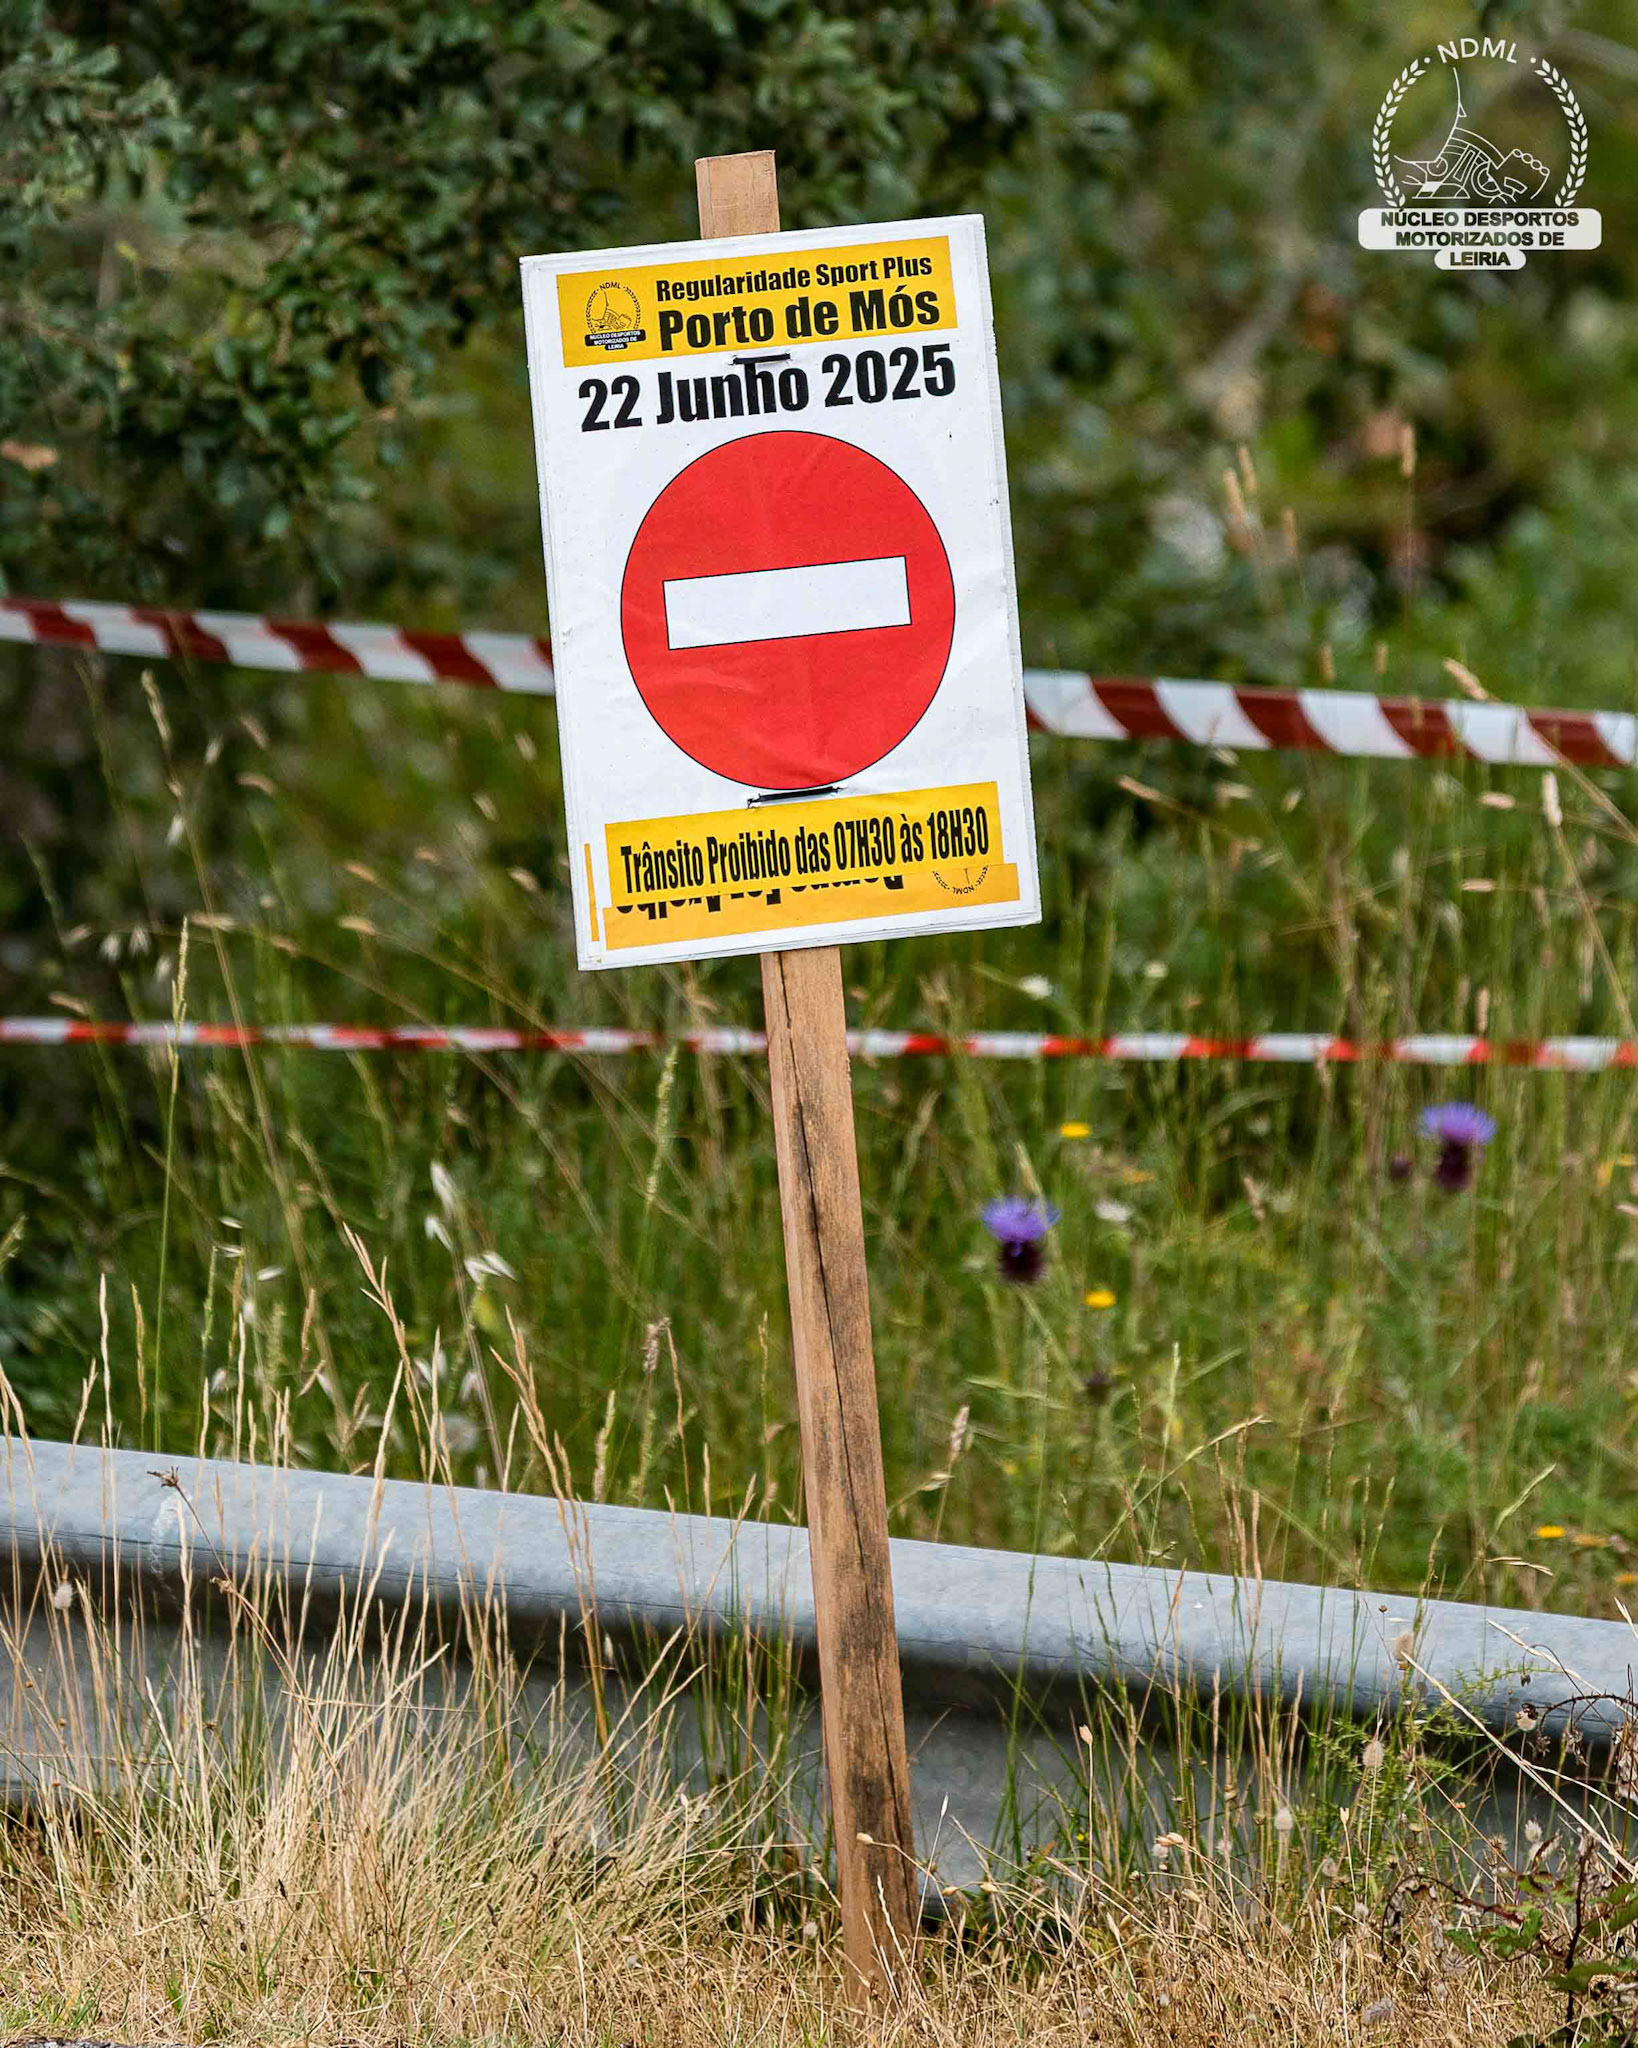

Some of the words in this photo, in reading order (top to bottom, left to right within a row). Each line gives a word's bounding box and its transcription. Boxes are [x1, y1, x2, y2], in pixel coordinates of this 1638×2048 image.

[599, 281, 621, 291] NDML
[656, 267, 811, 302] Regularidade
[816, 259, 879, 287] Sport
[883, 256, 933, 280] Plus
[658, 305, 775, 351] Porto
[785, 297, 839, 339] de
[849, 285, 940, 333] Mós
[578, 374, 643, 432] 22
[656, 362, 810, 425] Junho
[821, 343, 956, 408] 2025
[620, 837, 705, 894] Trânsito
[706, 829, 792, 885] Proibido
[795, 826, 831, 874] das
[833, 816, 897, 871] 07H30
[899, 813, 924, 864] às
[926, 806, 990, 861] 18H30
